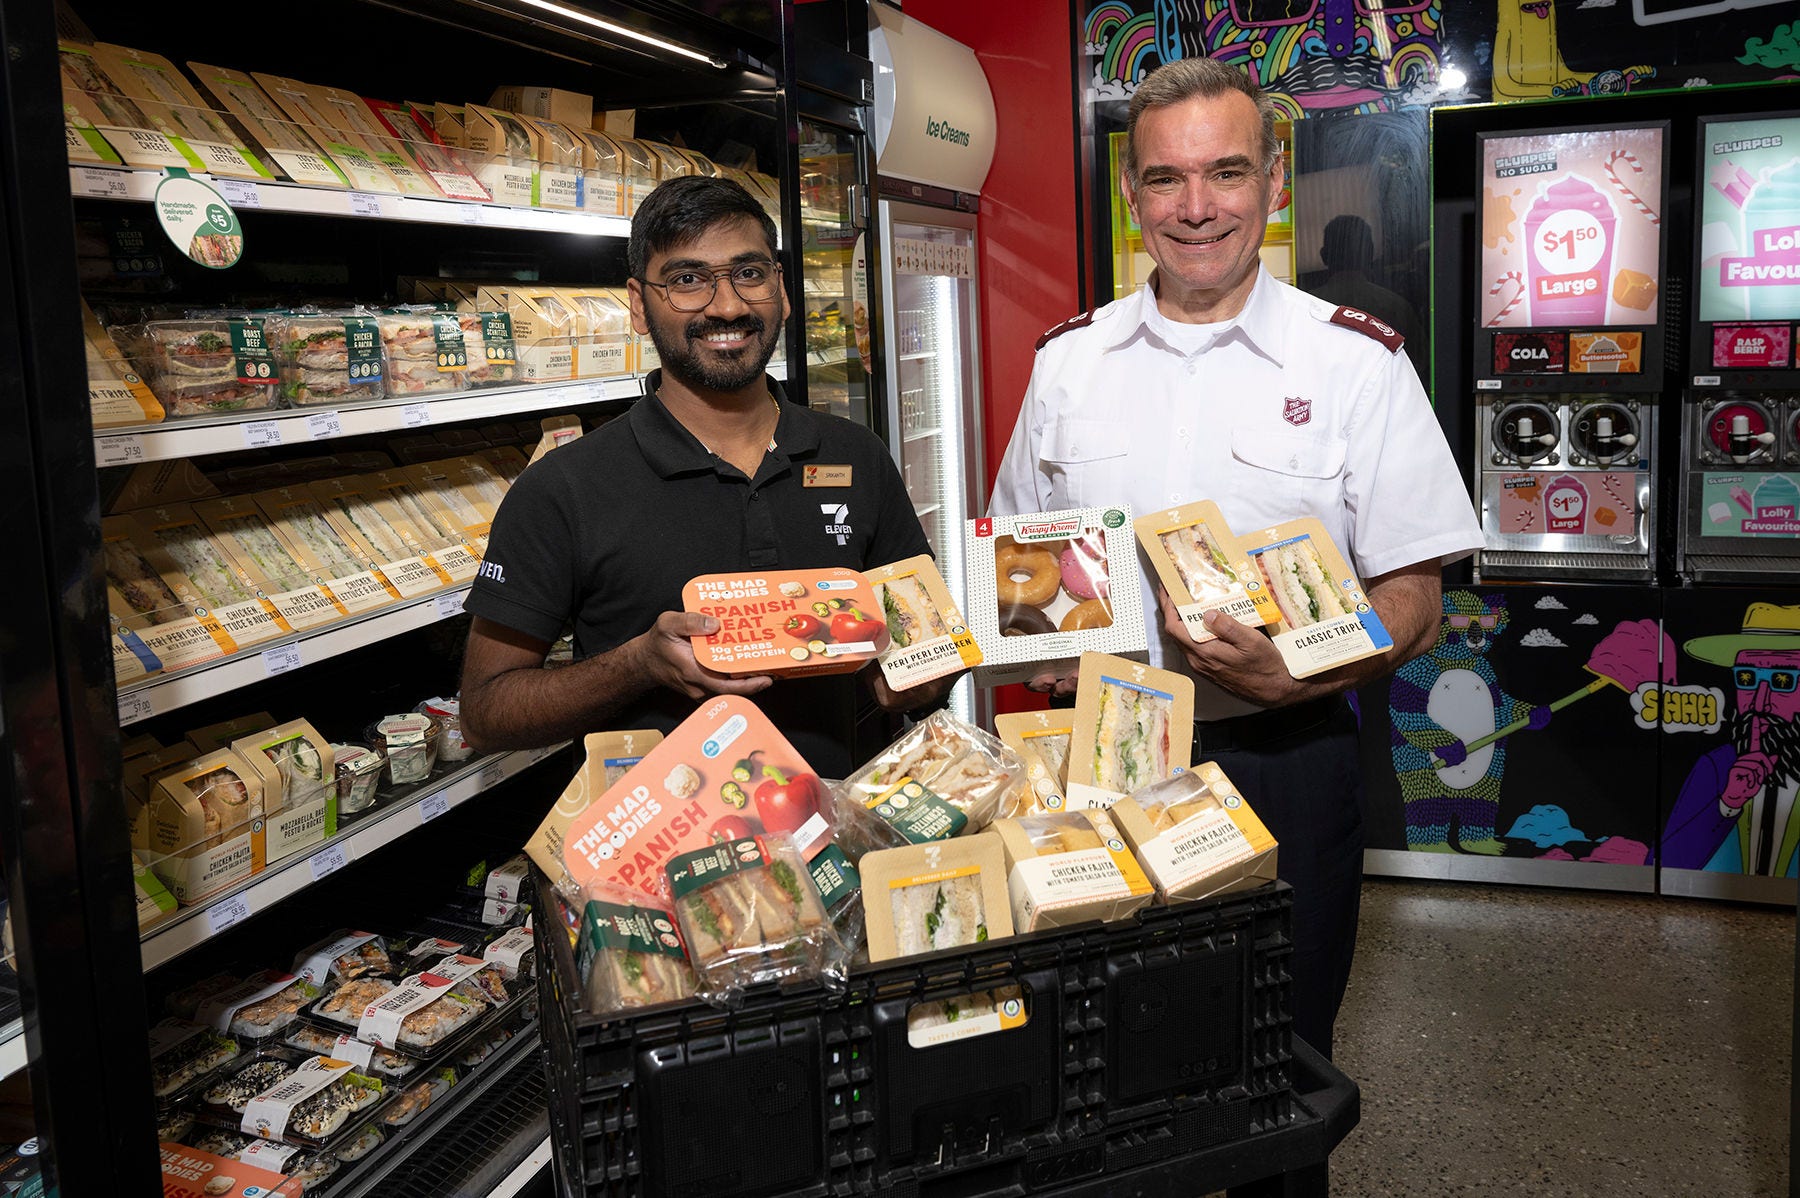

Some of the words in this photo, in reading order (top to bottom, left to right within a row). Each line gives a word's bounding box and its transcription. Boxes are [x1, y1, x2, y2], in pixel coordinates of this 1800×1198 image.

[926, 115, 940, 137] Ice
[940, 121, 970, 147] Creams
[138, 141, 172, 153] CHEESE
[1713, 136, 1782, 154] SLURPEE
[211, 153, 245, 165] LETTUCE
[1495, 152, 1557, 170] SLURPEE
[1500, 168, 1516, 177] NO
[1519, 164, 1554, 175] SUGAR
[160, 201, 197, 209] Handmade,
[211, 214, 227, 228] $5
[1541, 277, 1598, 295] Large
[488, 321, 506, 330] CHICKEN
[242, 329, 261, 339] ROAST
[353, 332, 373, 341] CHICKEN
[246, 338, 261, 348] BEEF
[358, 340, 373, 348] BACON
[1736, 338, 1765, 346] RASP
[592, 350, 608, 359] CHICKEN
[609, 348, 622, 357] TRIPLE
[1510, 348, 1549, 360] COLA
[1580, 352, 1628, 362] Butterscotch
[1733, 346, 1767, 355] BERRY
[100, 389, 137, 399] TRIPLE
[1293, 412, 1307, 421] ARMY
[1503, 476, 1535, 484] SLURPEE
[1708, 476, 1744, 484] SLURPEE
[1762, 508, 1791, 518] Lolly
[979, 523, 988, 532] 4
[1020, 523, 1049, 535] Krispy
[1049, 520, 1078, 532] Kreme
[1552, 520, 1579, 528] Large
[694, 581, 729, 591] THE
[729, 578, 767, 589] MAD
[289, 590, 321, 605] CHICKEN,
[338, 588, 364, 602] LETTUCE
[698, 587, 770, 601] FOODIES
[225, 606, 262, 621] CHICKEN,
[280, 602, 311, 617] LETTUCE
[699, 599, 797, 618] SPANISH
[1186, 612, 1206, 623] PER
[1230, 595, 1268, 612] CHICKEN
[222, 619, 248, 633] TTUCE
[721, 616, 763, 631] EAT
[145, 635, 167, 648] PERI
[167, 631, 187, 642] PERI
[187, 623, 221, 638] CHICKEN
[705, 628, 777, 646] BALLS
[1295, 629, 1333, 650] CLASSIC
[1333, 620, 1367, 638] TRIPLE
[709, 646, 732, 655] 10g
[733, 641, 773, 653] CARBS
[711, 653, 734, 663] 24g
[736, 648, 787, 660] PROTEIN
[887, 658, 909, 670] PERI
[910, 650, 932, 662] PERI
[933, 638, 972, 655] CHICKEN
[906, 662, 920, 670] WITH
[920, 655, 943, 665] CRUNCHY
[943, 650, 958, 658] SLAW
[706, 700, 729, 720] 300g
[1641, 688, 1717, 726] SHHH
[280, 813, 314, 832] MOZZARELLA,
[572, 820, 612, 856] THE
[606, 785, 650, 827] MAD
[907, 805, 946, 834] SCHNITZEL
[920, 814, 952, 839] CHICKEN
[284, 826, 301, 839] PESTO
[586, 798, 663, 871] FOODIES
[1174, 835, 1208, 855] CHICKEN
[1208, 823, 1235, 840] FAJITA
[209, 855, 233, 871] CHICKEN
[233, 846, 250, 860] FAJITA
[1171, 856, 1185, 866] WITH
[1185, 846, 1208, 859] TOMATO
[1207, 838, 1223, 850] SALSA
[820, 858, 844, 889] CHICKEN
[1052, 865, 1087, 878] CHICKEN
[1087, 861, 1115, 872] FAJITA
[815, 873, 834, 897] BACON
[1046, 879, 1062, 887] WITH
[1062, 876, 1085, 884] TOMATO
[160, 1148, 182, 1161] HE
[179, 1157, 214, 1173] MAD
